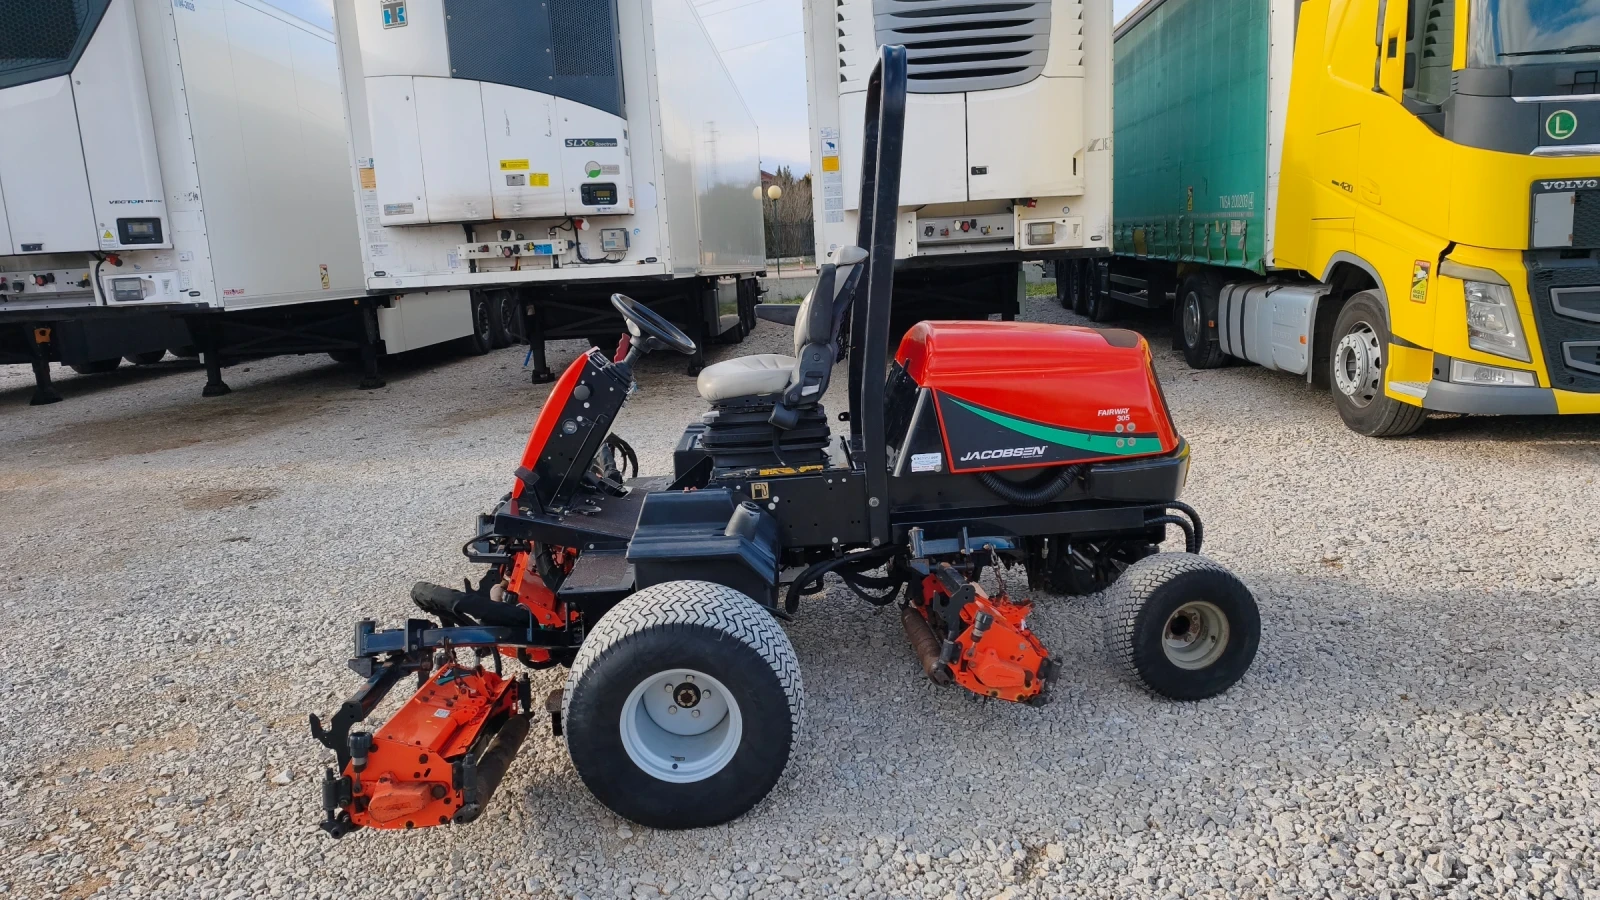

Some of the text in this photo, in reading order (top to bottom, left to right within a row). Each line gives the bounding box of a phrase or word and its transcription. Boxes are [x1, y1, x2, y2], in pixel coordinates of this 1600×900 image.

[1555, 117, 1567, 134] L
[1340, 181, 1354, 193] 420
[1540, 179, 1598, 190] VOLVO
[1098, 408, 1130, 416] FAIRWAY
[960, 445, 1046, 462] JACOBSEN
